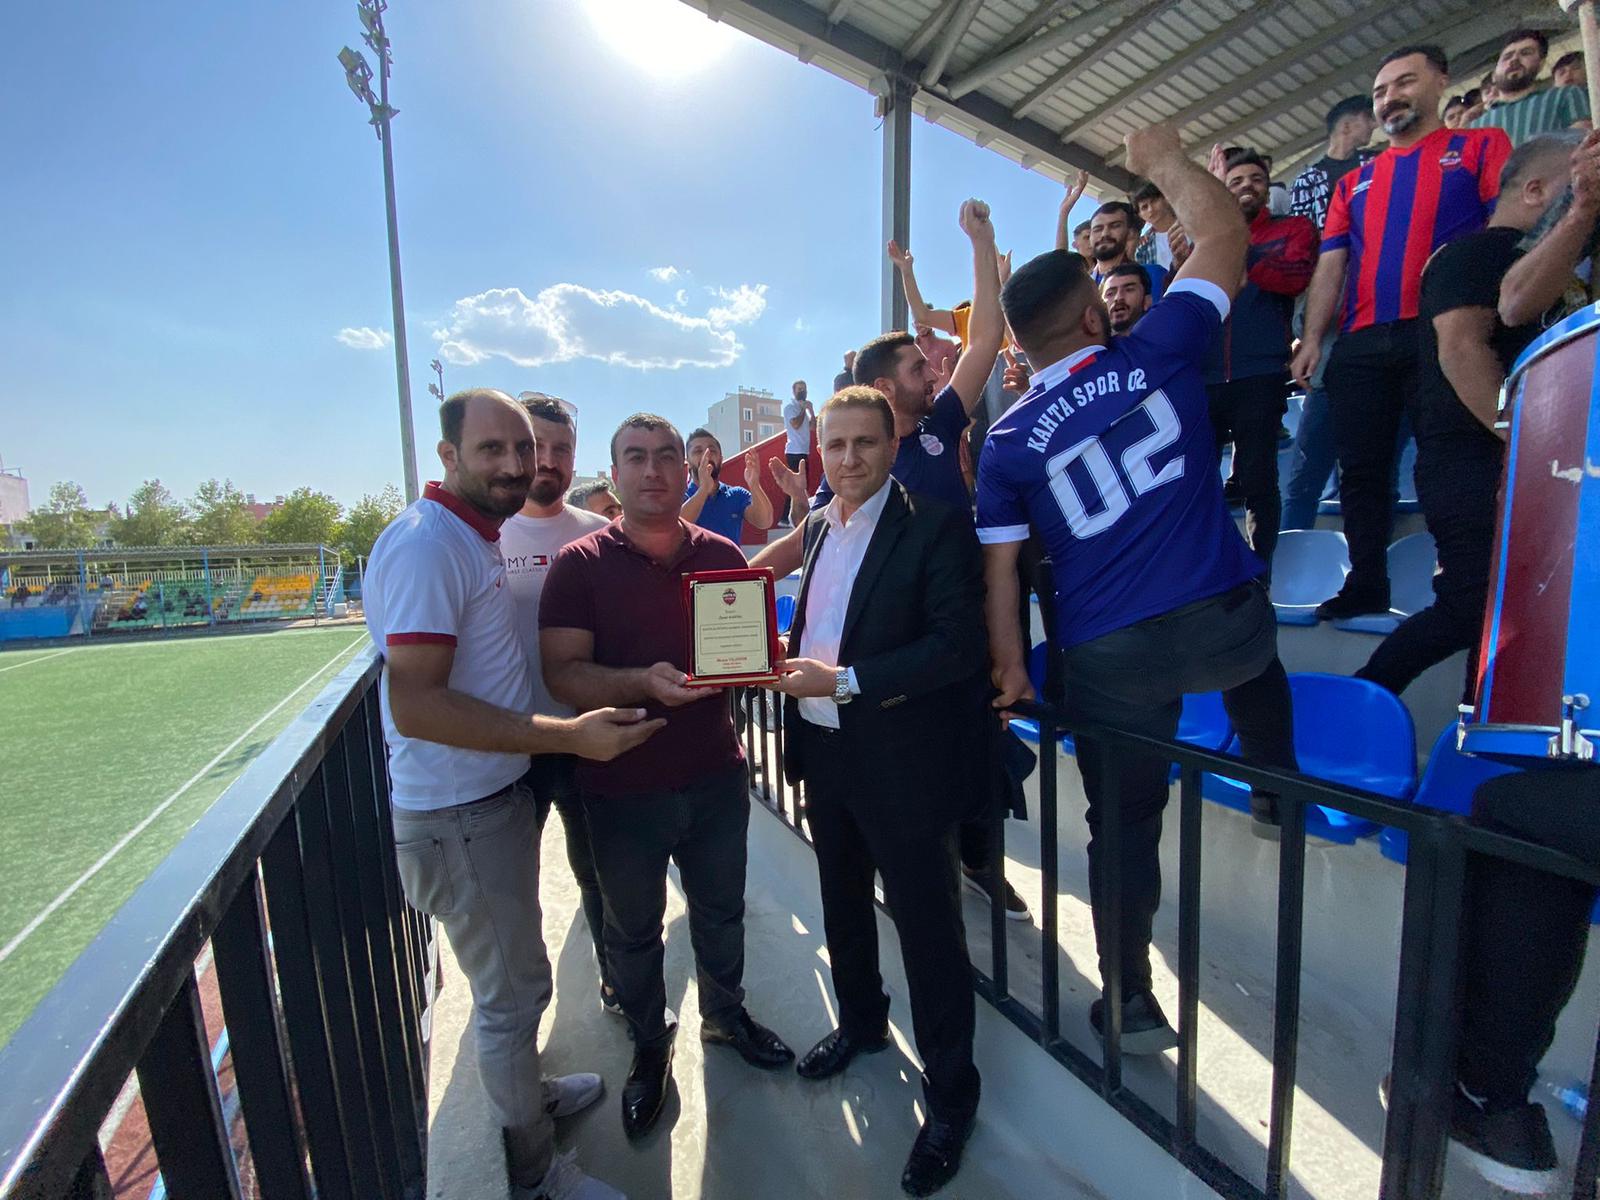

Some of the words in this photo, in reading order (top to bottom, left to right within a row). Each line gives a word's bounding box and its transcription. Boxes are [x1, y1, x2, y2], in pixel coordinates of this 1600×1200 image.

[1027, 396, 1075, 454] KAHTA
[1073, 371, 1120, 408] SPOR
[1127, 368, 1148, 392] 02
[1046, 388, 1185, 540] 02
